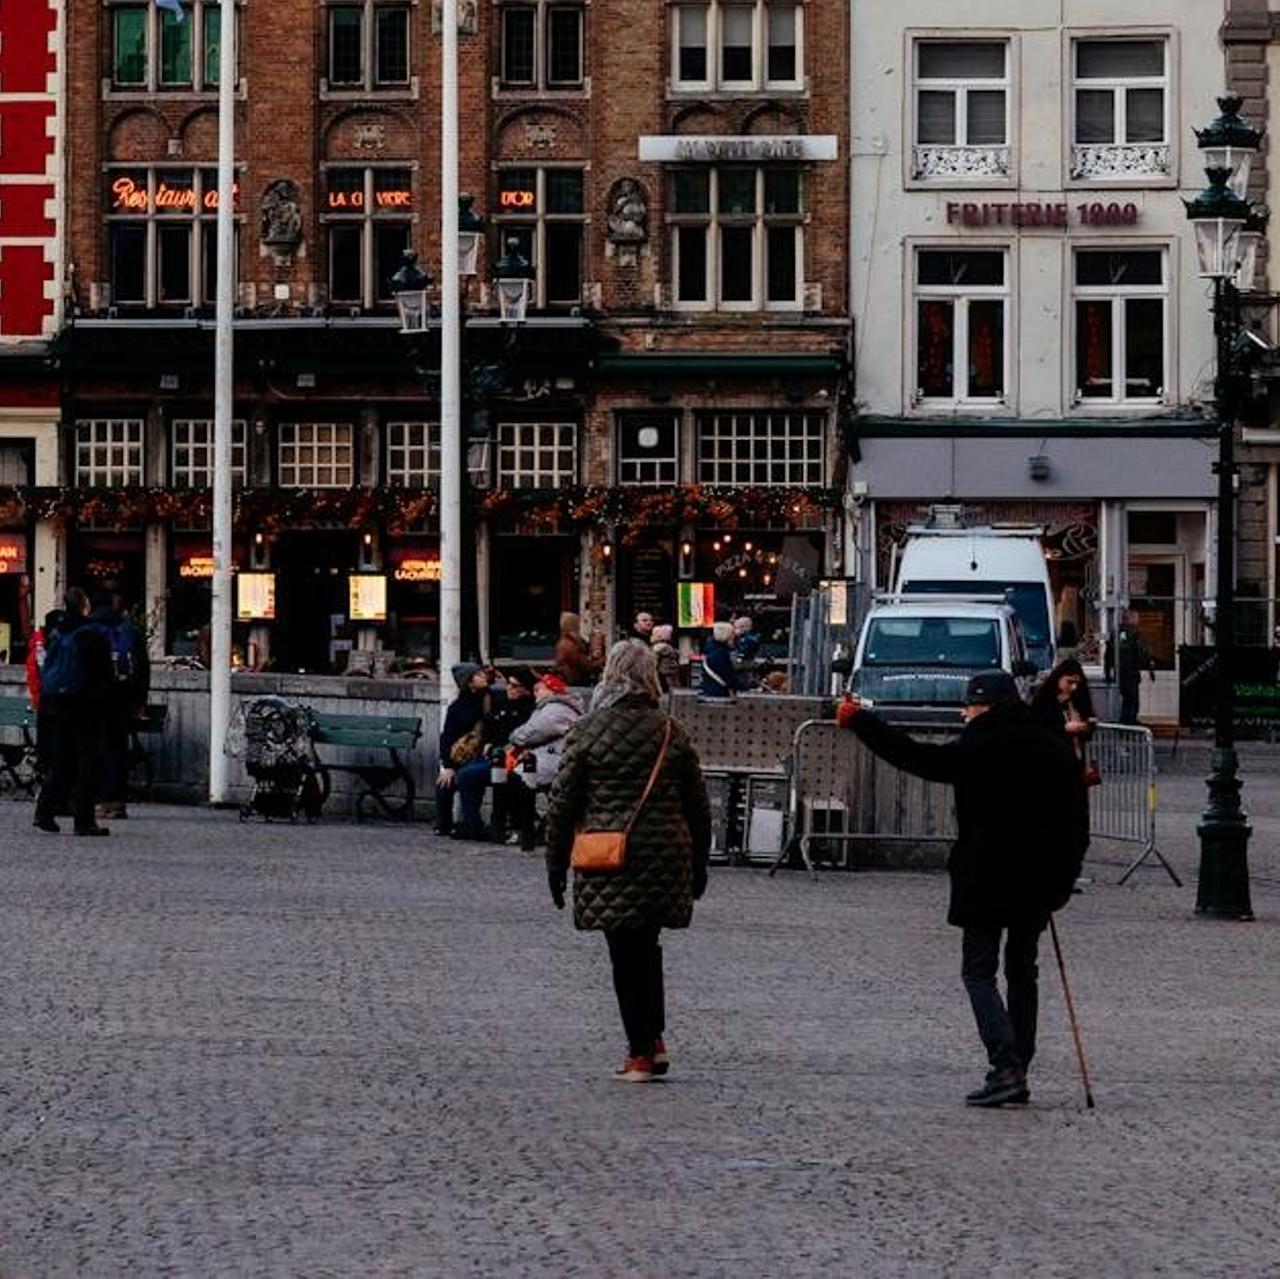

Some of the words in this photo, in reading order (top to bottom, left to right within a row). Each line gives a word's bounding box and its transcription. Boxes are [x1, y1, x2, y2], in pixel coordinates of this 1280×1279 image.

[113, 178, 238, 208] Restaurat
[329, 191, 346, 207] LA
[946, 202, 1068, 226] FRITERIE
